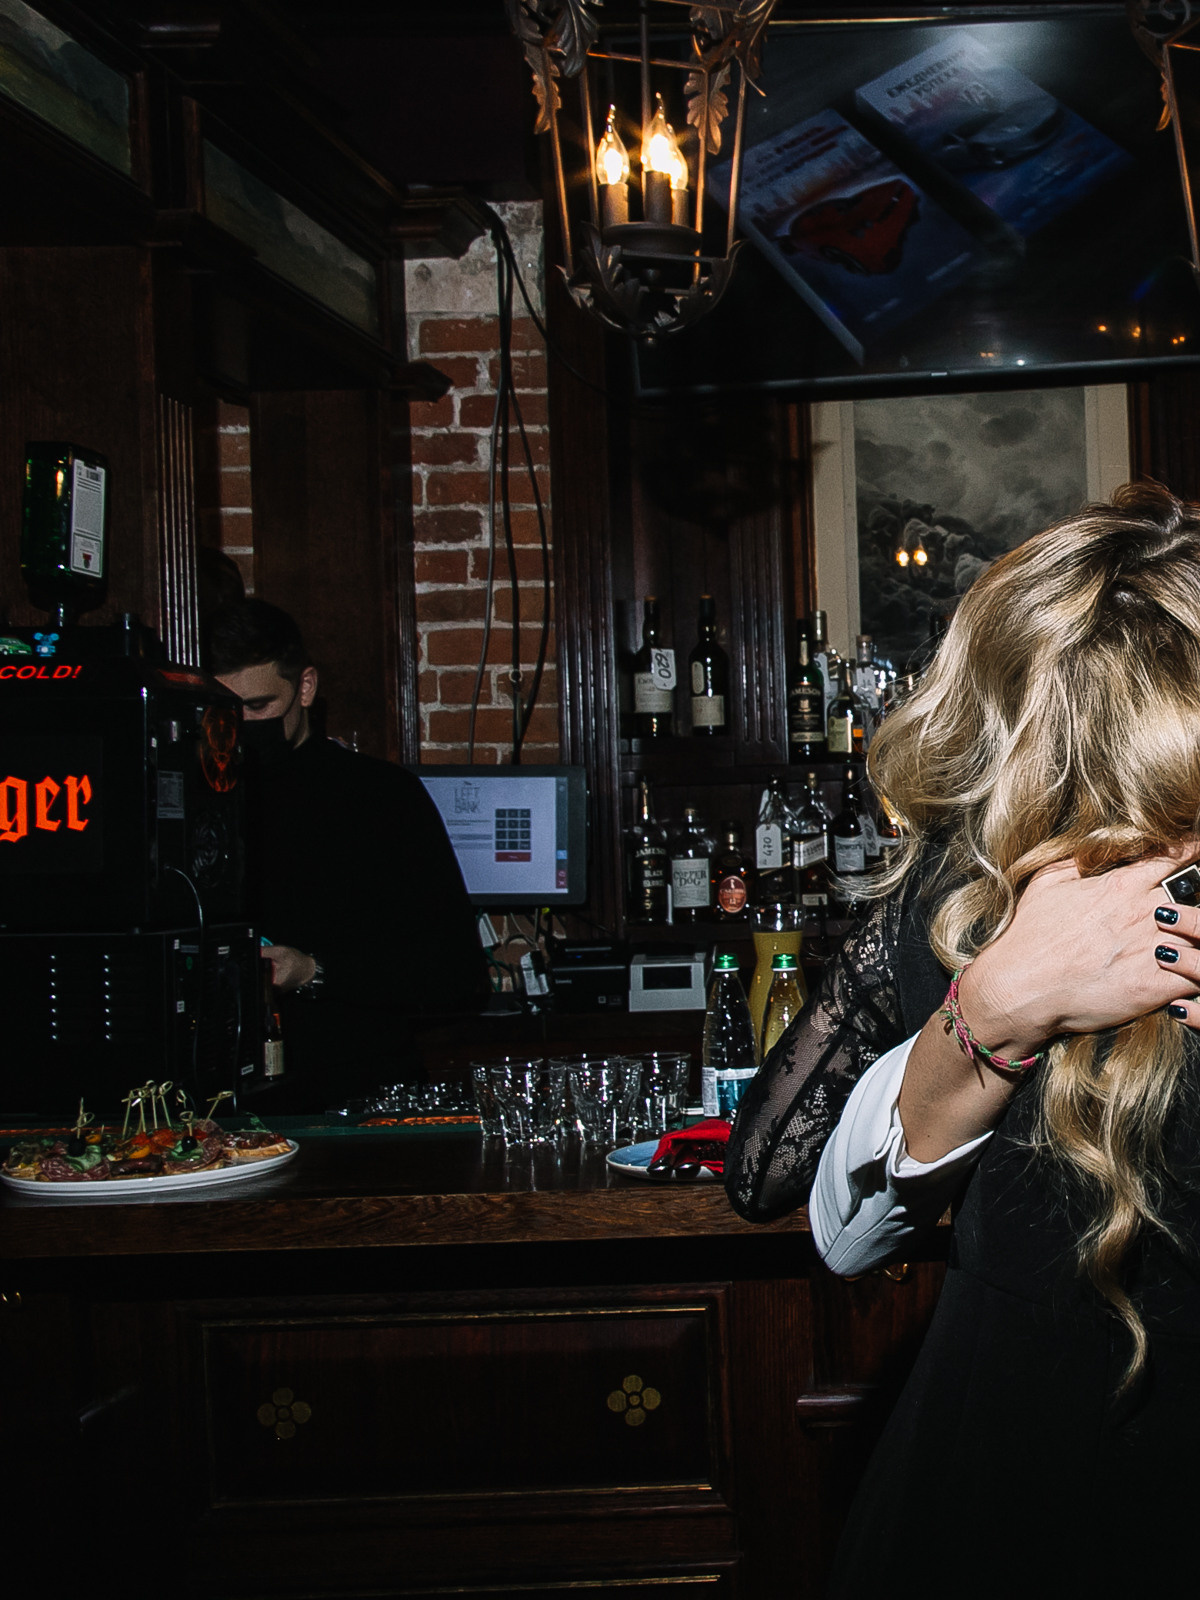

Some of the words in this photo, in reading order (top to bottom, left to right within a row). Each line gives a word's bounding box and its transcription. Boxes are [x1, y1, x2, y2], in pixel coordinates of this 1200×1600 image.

[0, 665, 83, 680] COLD!
[654, 652, 672, 679] 620
[454, 786, 480, 800] LEFT
[454, 800, 478, 814] BANK
[673, 869, 707, 879] COPPER
[680, 878, 701, 887] DOG
